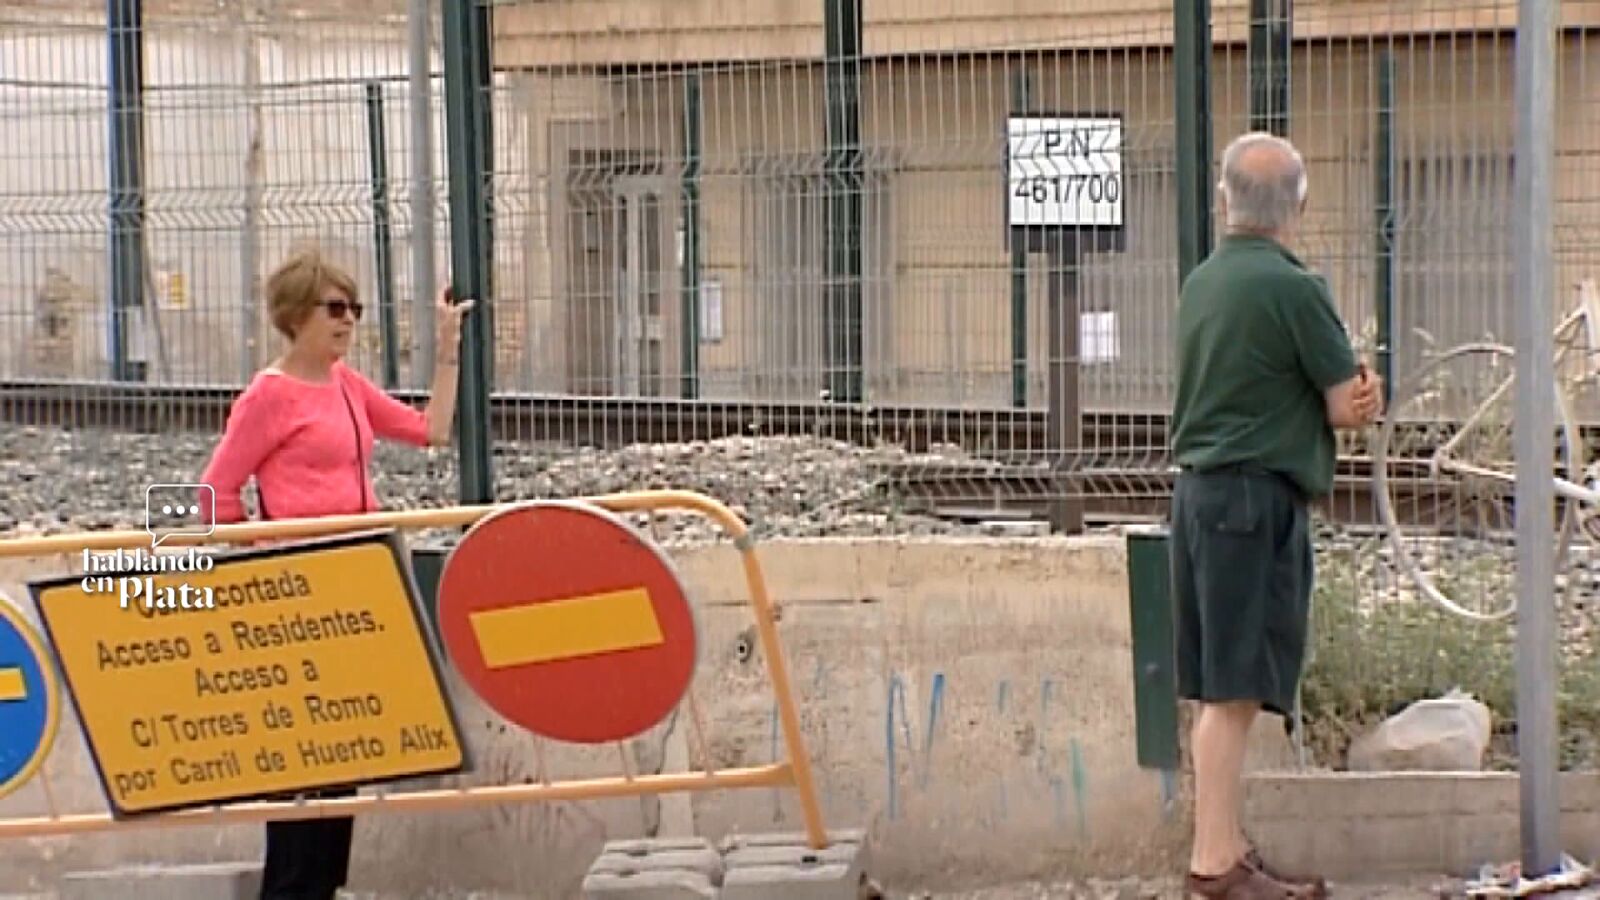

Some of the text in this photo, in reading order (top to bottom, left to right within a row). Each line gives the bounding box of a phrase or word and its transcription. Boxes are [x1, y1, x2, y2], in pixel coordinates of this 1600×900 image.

[1014, 174, 1119, 204] 461/700
[214, 570, 312, 607] cortada
[97, 609, 386, 671] Acceso a Residentes.
[194, 658, 319, 697] Acceso a
[262, 706, 294, 730] de
[305, 693, 382, 725] Romo
[115, 724, 448, 800] por Carril de Huerto Alix
